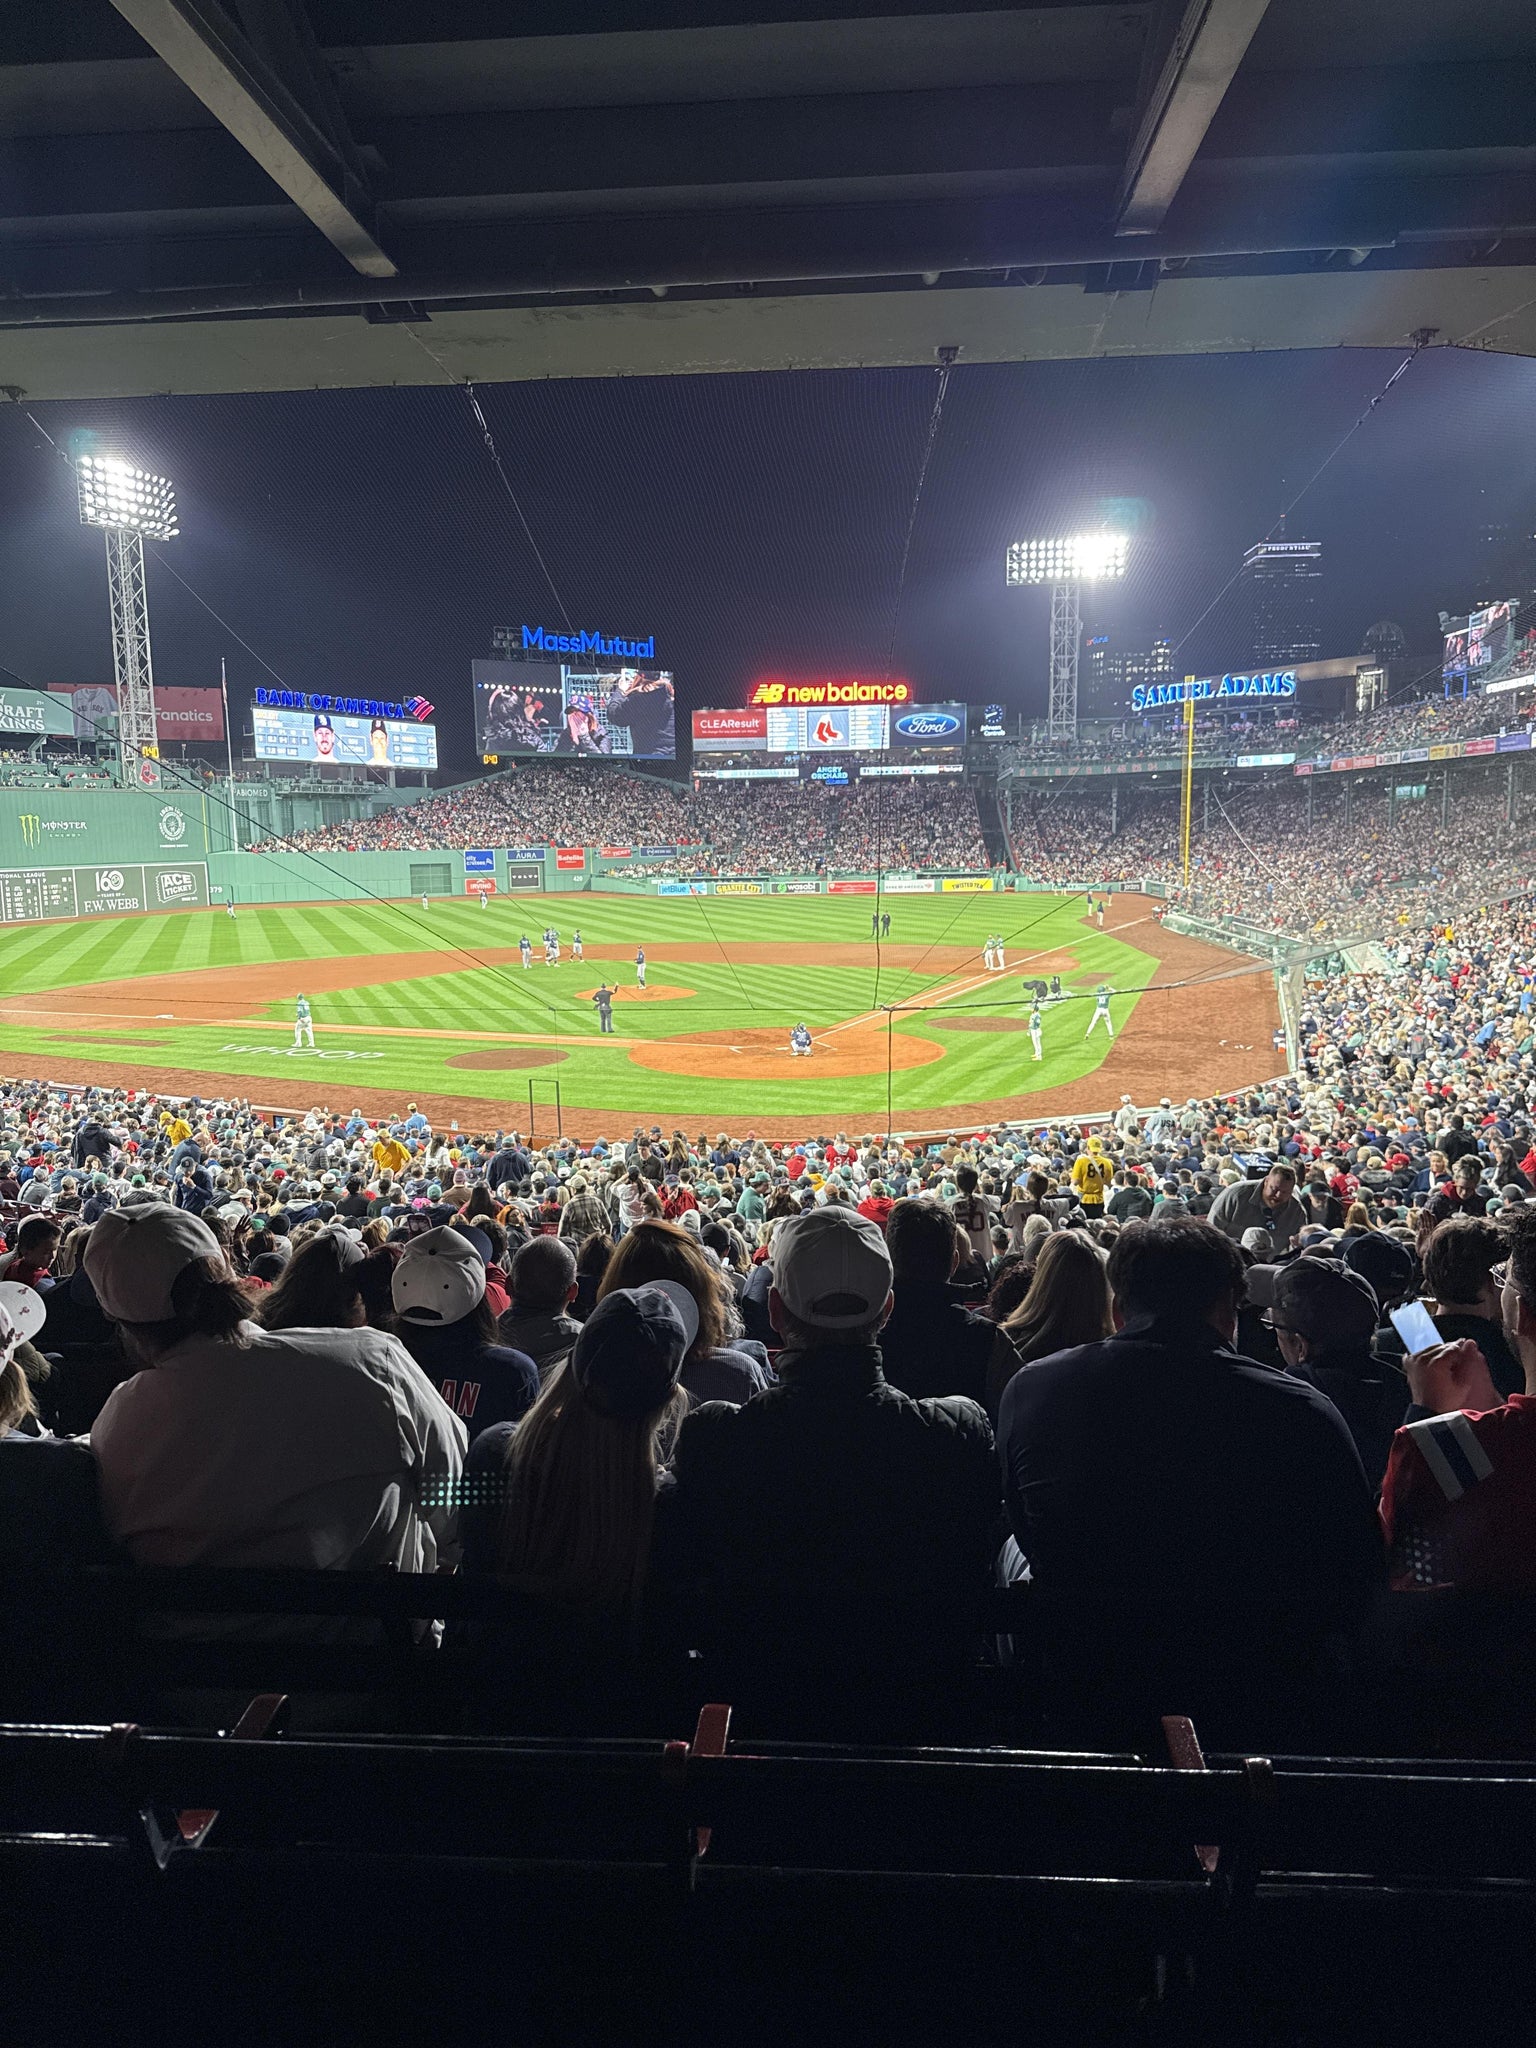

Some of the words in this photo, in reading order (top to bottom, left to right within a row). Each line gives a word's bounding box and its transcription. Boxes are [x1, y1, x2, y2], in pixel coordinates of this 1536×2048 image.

[522, 624, 655, 658] MassMutual
[787, 686, 826, 703] new
[827, 681, 908, 702] balance
[1131, 680, 1215, 711] SAMUEL
[1216, 670, 1297, 696] ADAMS
[255, 687, 307, 709] BANK
[309, 693, 332, 710] OF
[335, 697, 405, 719] AMERICA
[155, 707, 214, 723] Fanatics
[0, 715, 45, 731] KINGS
[700, 718, 760, 729] CLEAResult
[908, 717, 947, 733] Ford
[41, 820, 88, 831] MONSTER
[164, 873, 192, 888] ACE
[951, 882, 973, 890] TWISTED
[164, 884, 193, 897] TICKET
[661, 884, 687, 894] jetBlue
[84, 899, 105, 912] F.W.
[106, 897, 139, 910] WEBB
[218, 1044, 386, 1059] WHOOP
[1161, 1119, 1176, 1128] USA
[431, 1378, 482, 1418] AN
